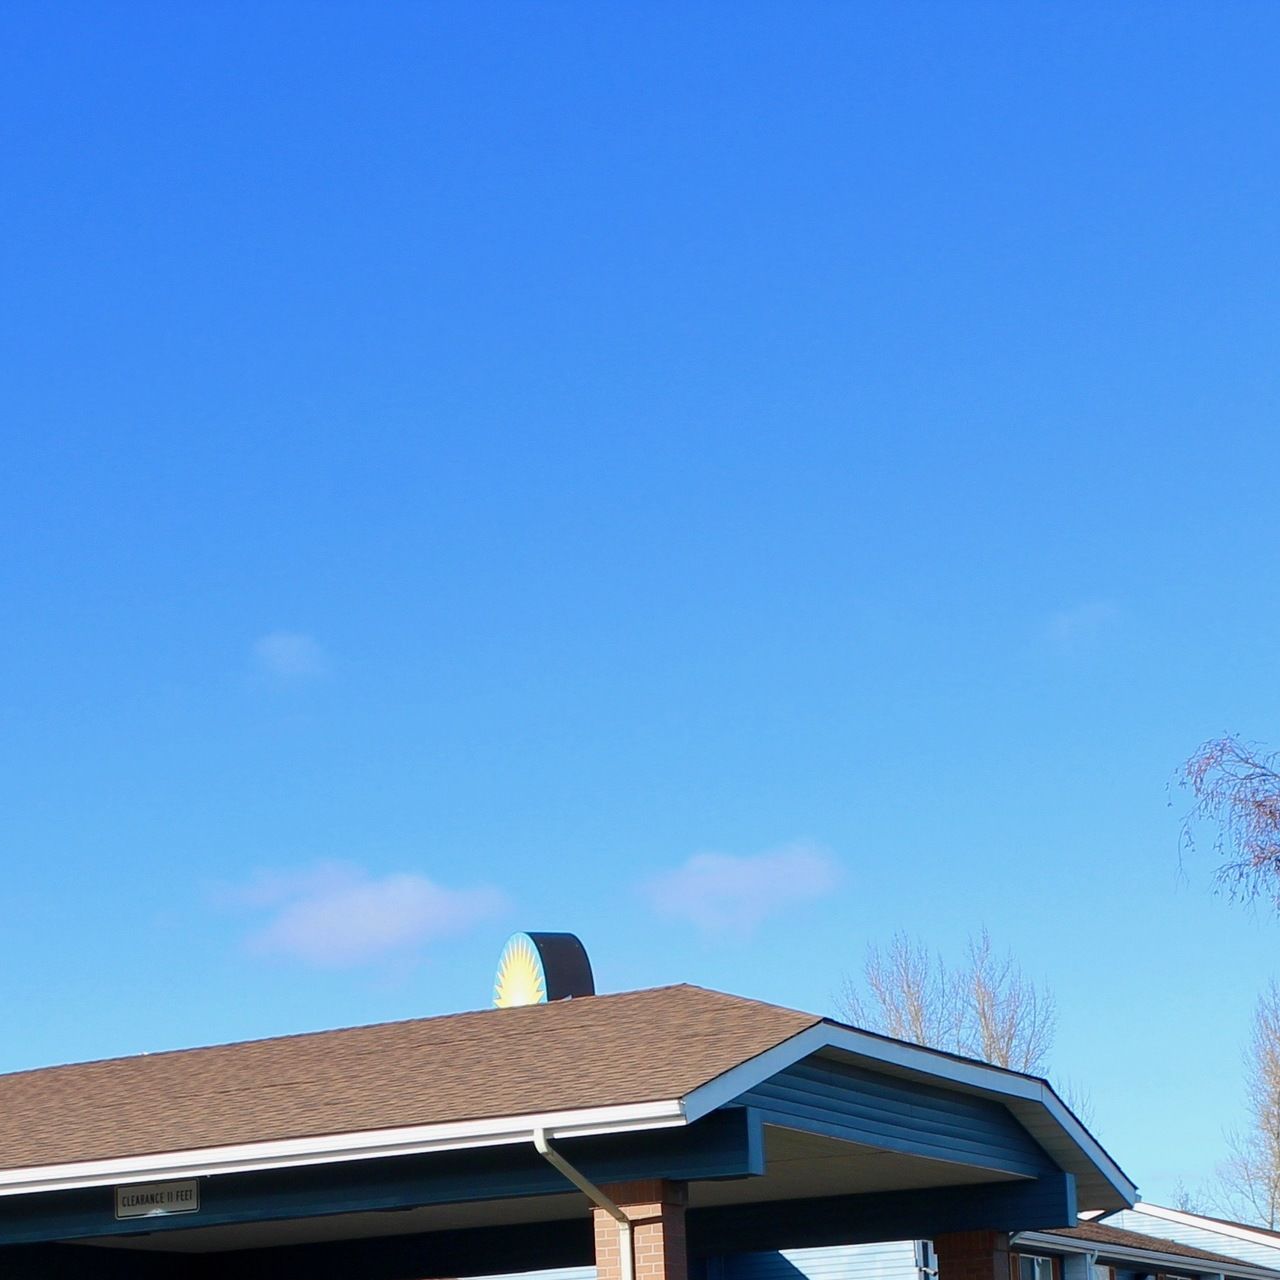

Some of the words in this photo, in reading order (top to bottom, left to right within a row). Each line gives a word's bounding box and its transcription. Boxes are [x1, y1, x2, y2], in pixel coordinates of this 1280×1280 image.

[122, 1192, 164, 1207] CLEARANCE
[167, 1191, 173, 1203] 11
[176, 1189, 193, 1201] FEET
